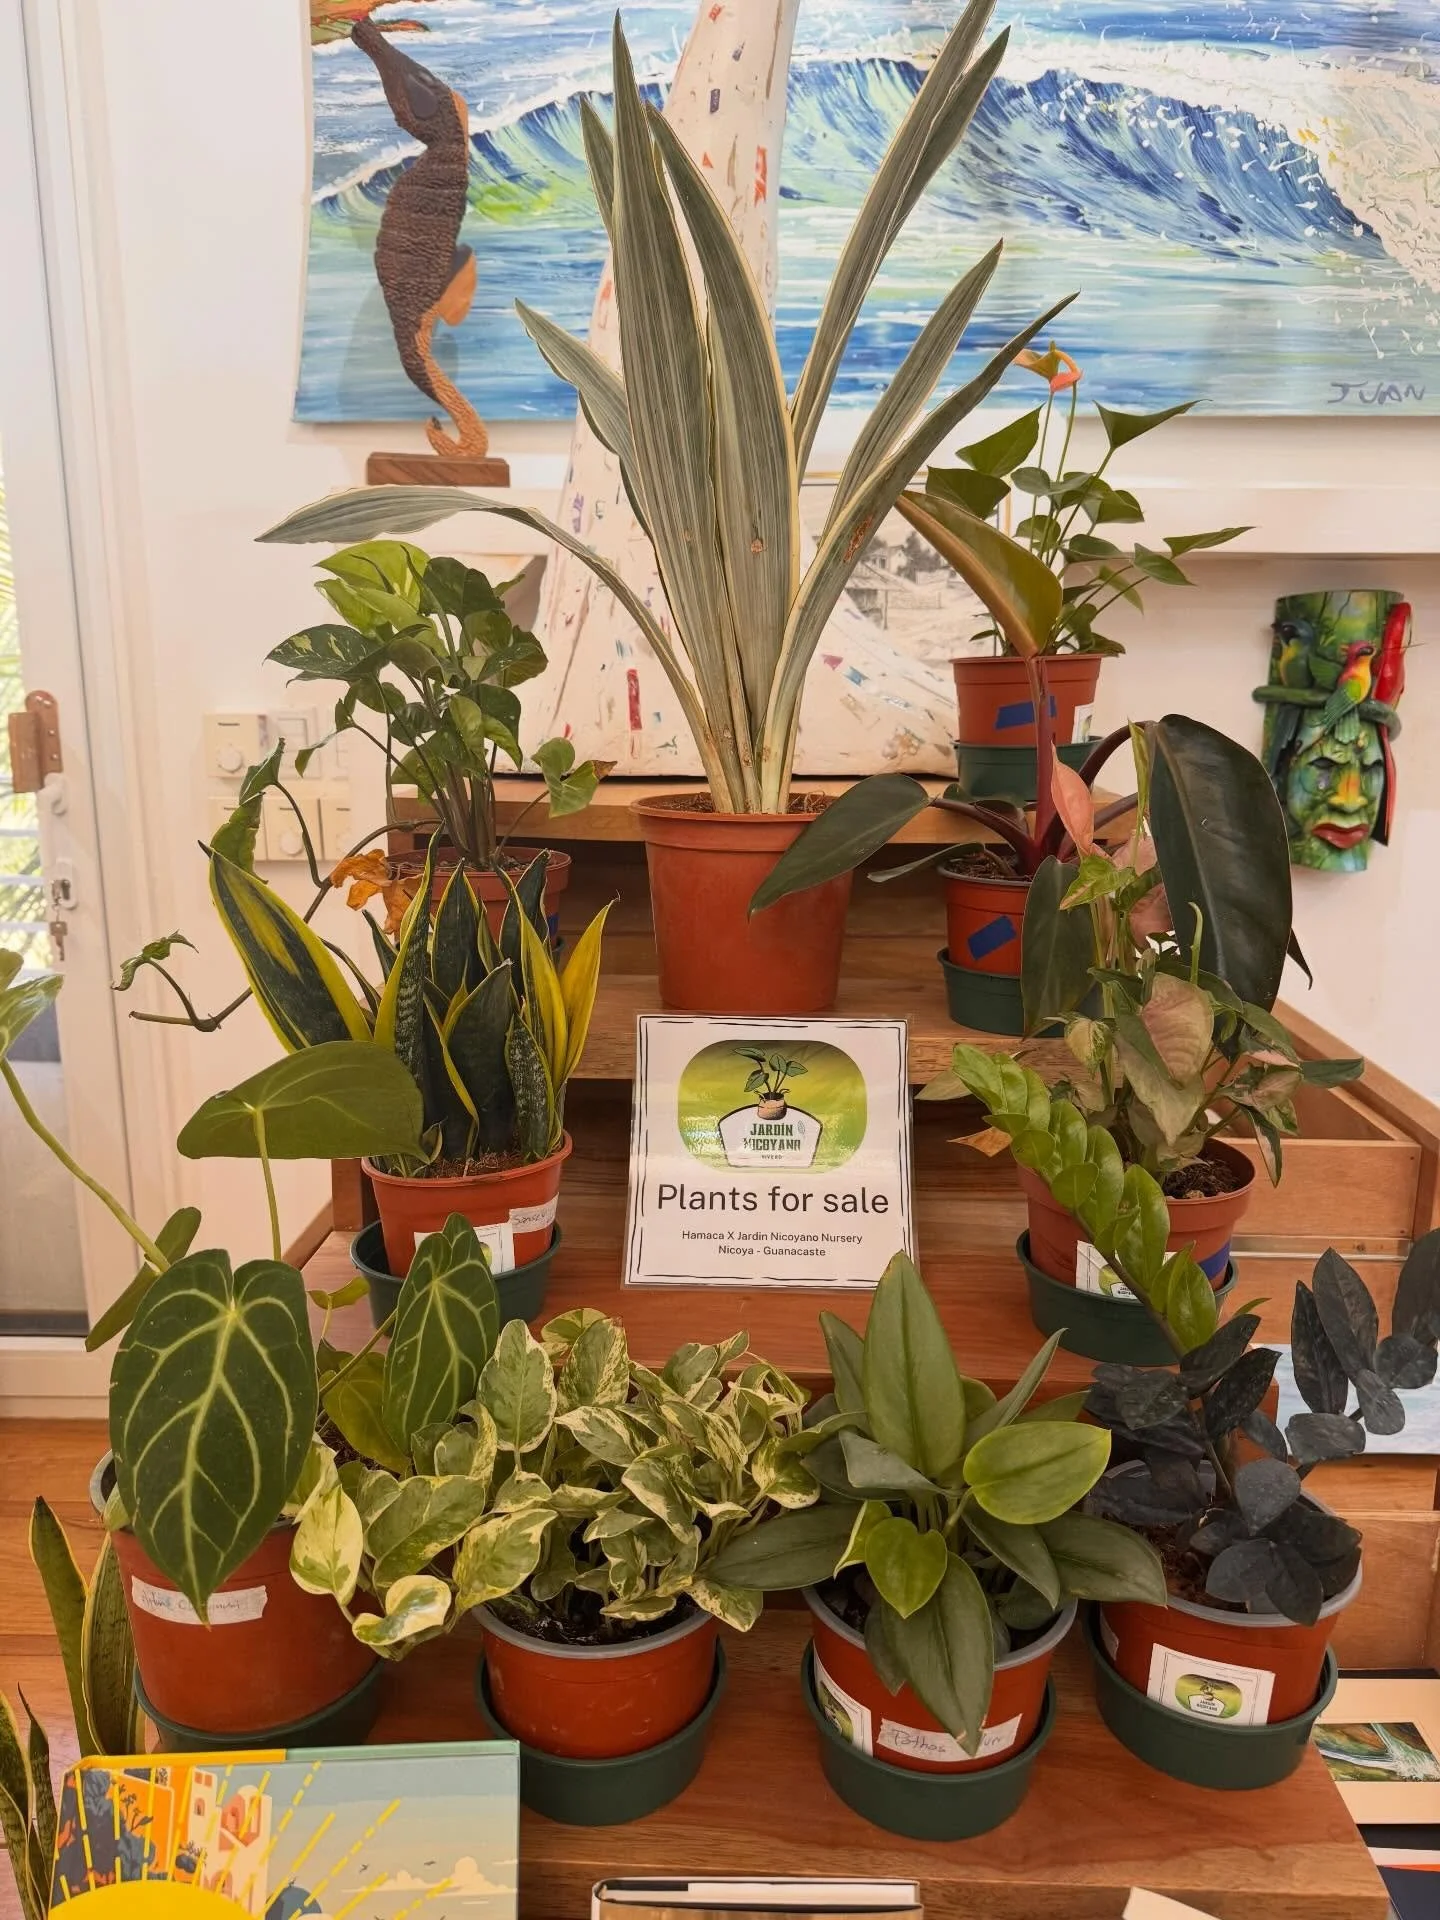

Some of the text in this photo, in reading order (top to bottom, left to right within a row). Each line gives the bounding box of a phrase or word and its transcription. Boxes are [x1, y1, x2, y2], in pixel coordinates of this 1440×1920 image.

[1327, 381, 1426, 406] JUAN
[658, 1184, 889, 1214] Plants for sale
[682, 1230, 725, 1241] Hamaca
[727, 1231, 735, 1240] X
[770, 1232, 819, 1243] Nicoyano
[821, 1233, 863, 1244] Nursery
[718, 1245, 754, 1256] Nicoya
[763, 1246, 826, 1257] Guanacaste
